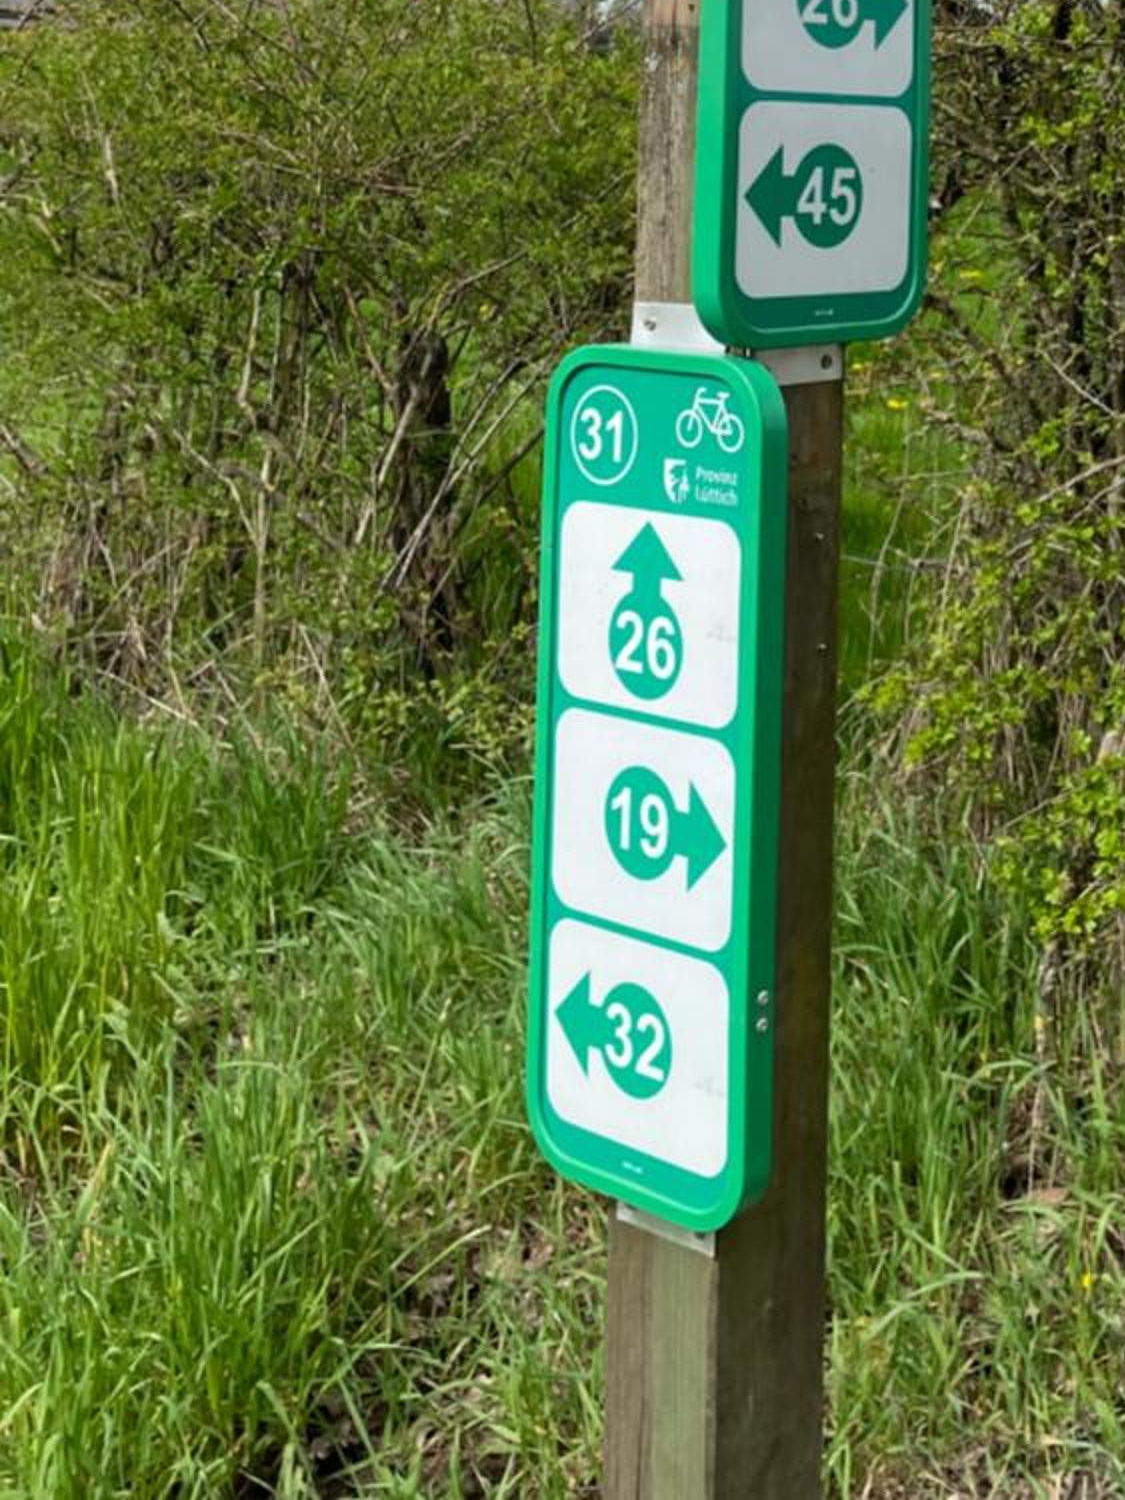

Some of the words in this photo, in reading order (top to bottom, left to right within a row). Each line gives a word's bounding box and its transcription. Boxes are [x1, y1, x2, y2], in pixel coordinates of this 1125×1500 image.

[797, 167, 857, 226] 45
[578, 407, 623, 463] 31
[614, 610, 676, 680] 26
[611, 787, 669, 859] 19
[604, 1002, 666, 1082] 32
